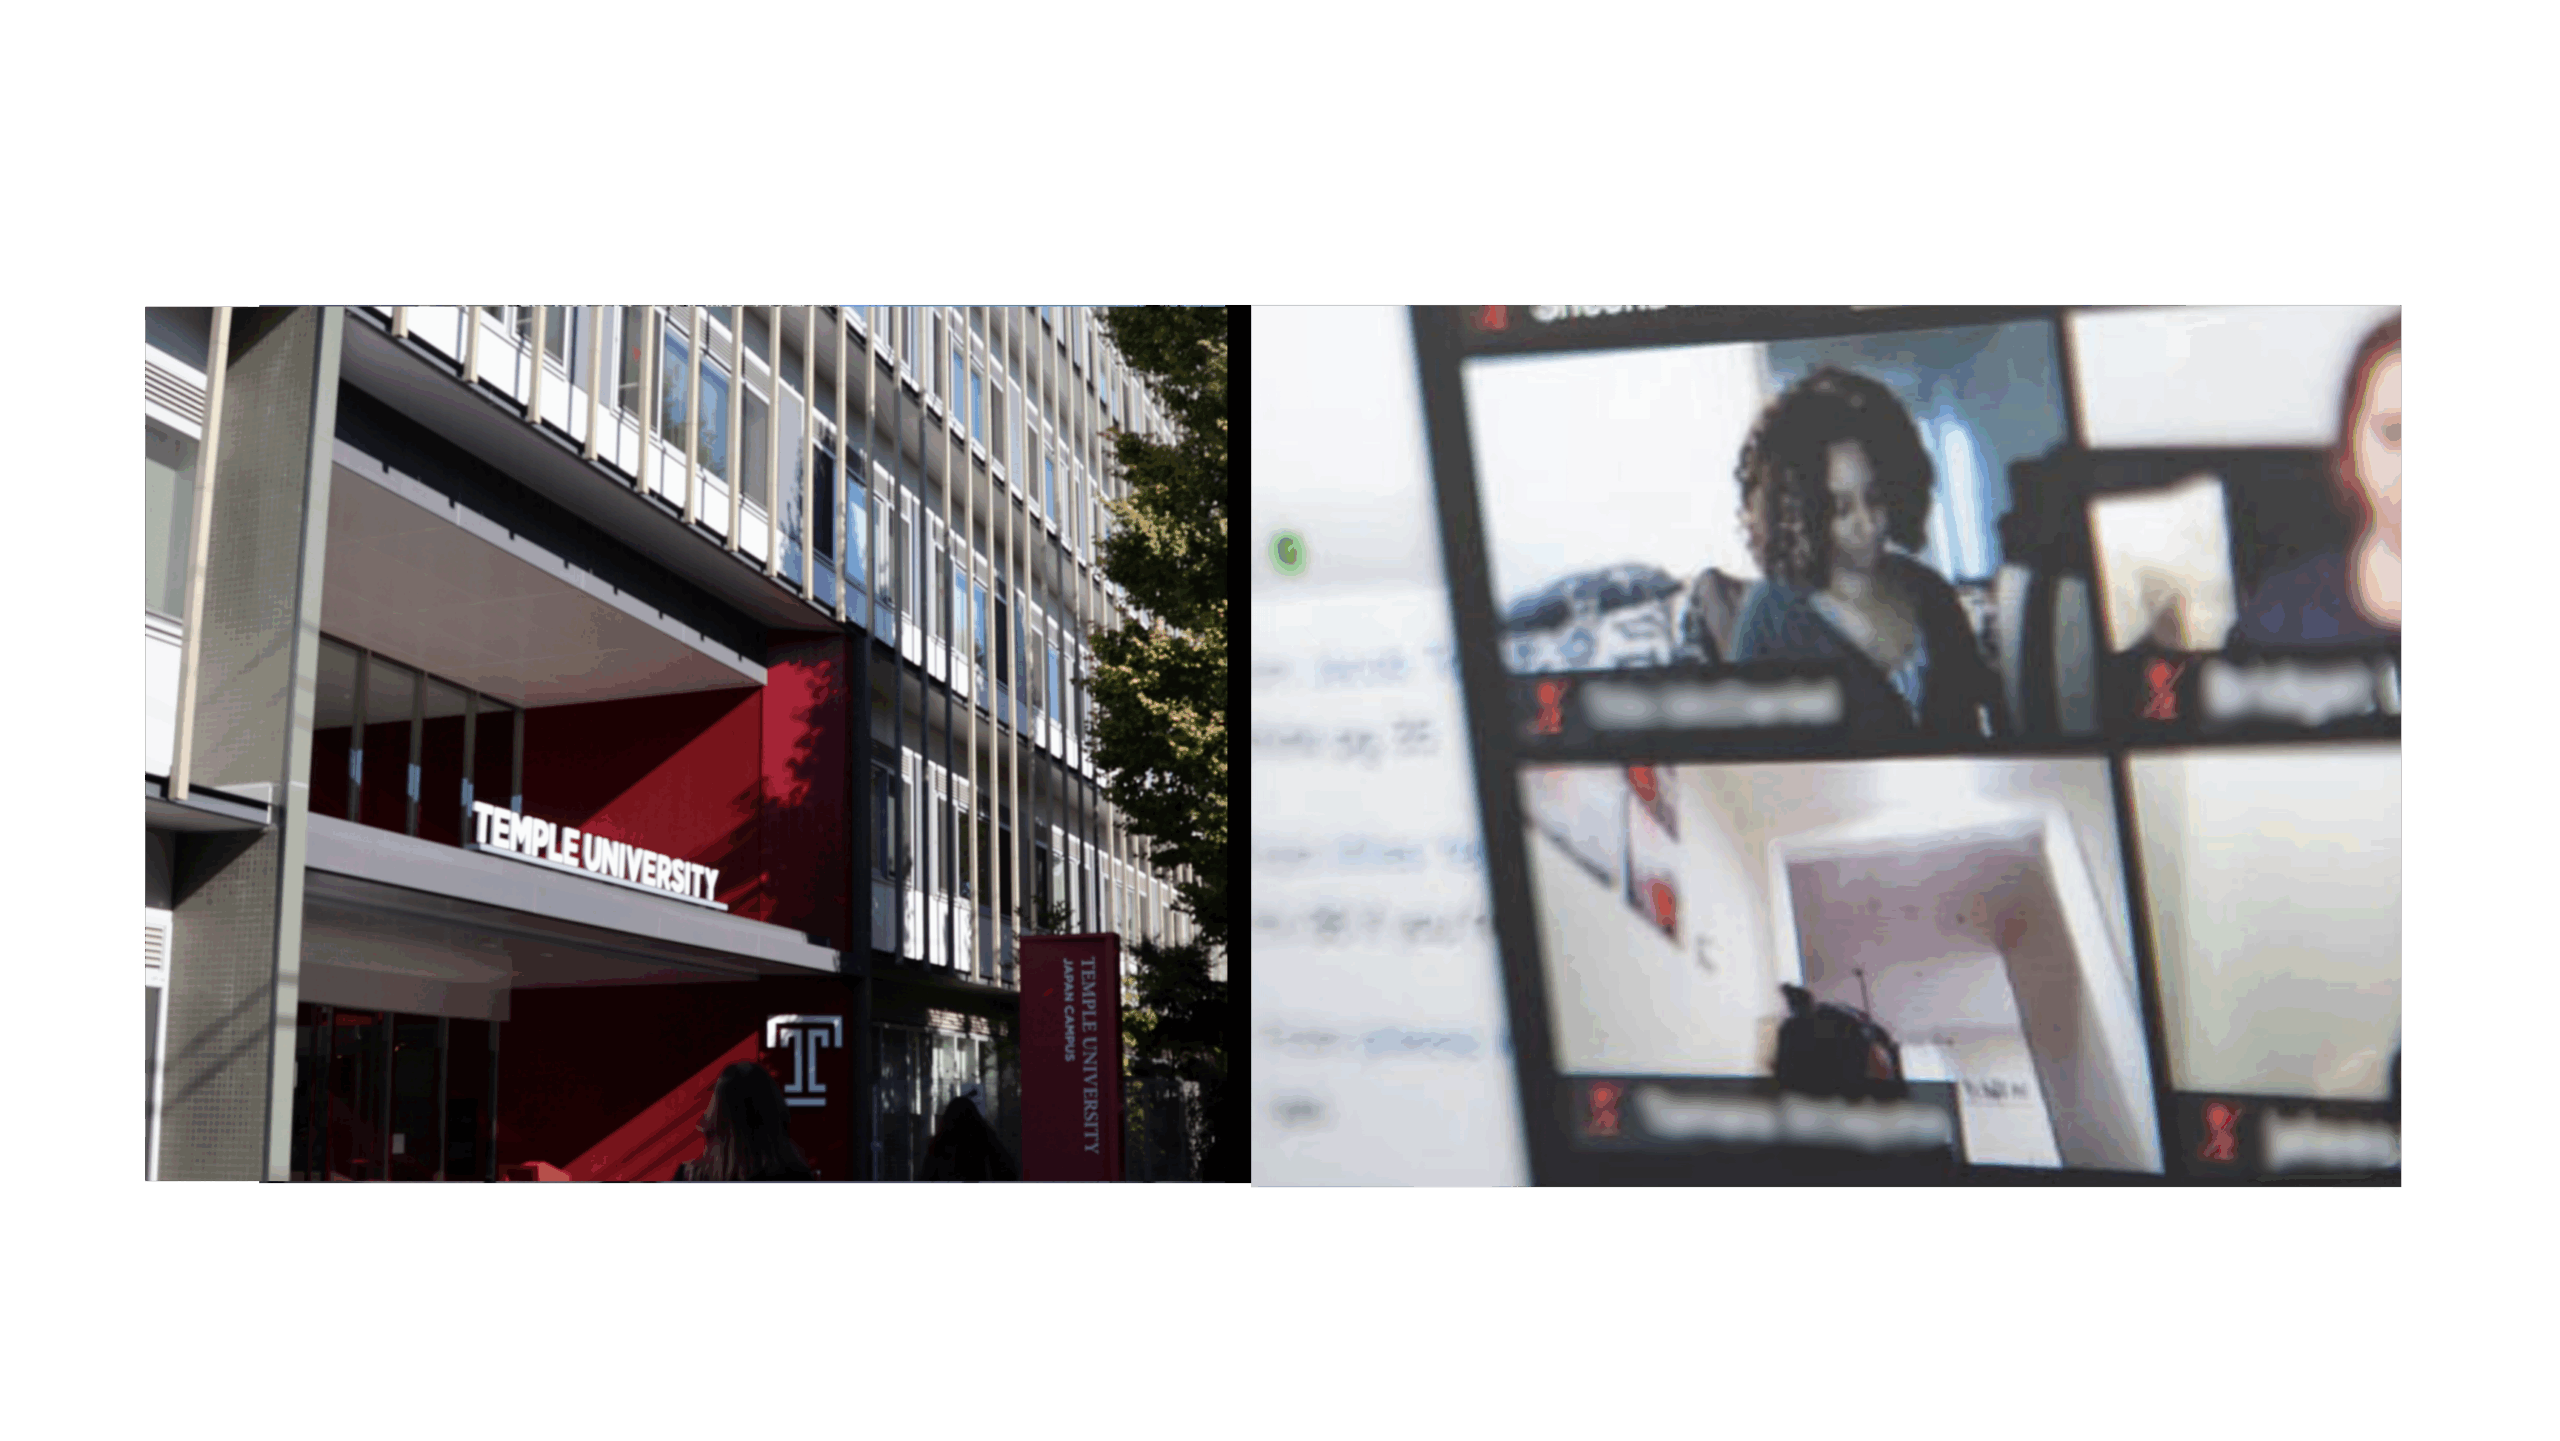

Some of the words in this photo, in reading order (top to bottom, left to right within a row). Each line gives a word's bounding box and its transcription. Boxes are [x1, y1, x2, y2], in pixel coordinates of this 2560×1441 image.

[473, 800, 581, 868] TEMPLE
[582, 832, 719, 901] UNIVERSITY
[1063, 958, 1075, 1002] JAPAN
[1080, 956, 1098, 1032] TEMPLE
[766, 1014, 843, 1107] T
[1064, 1005, 1076, 1062] CAMPUS
[1082, 1037, 1100, 1155] UNIVERSITY
